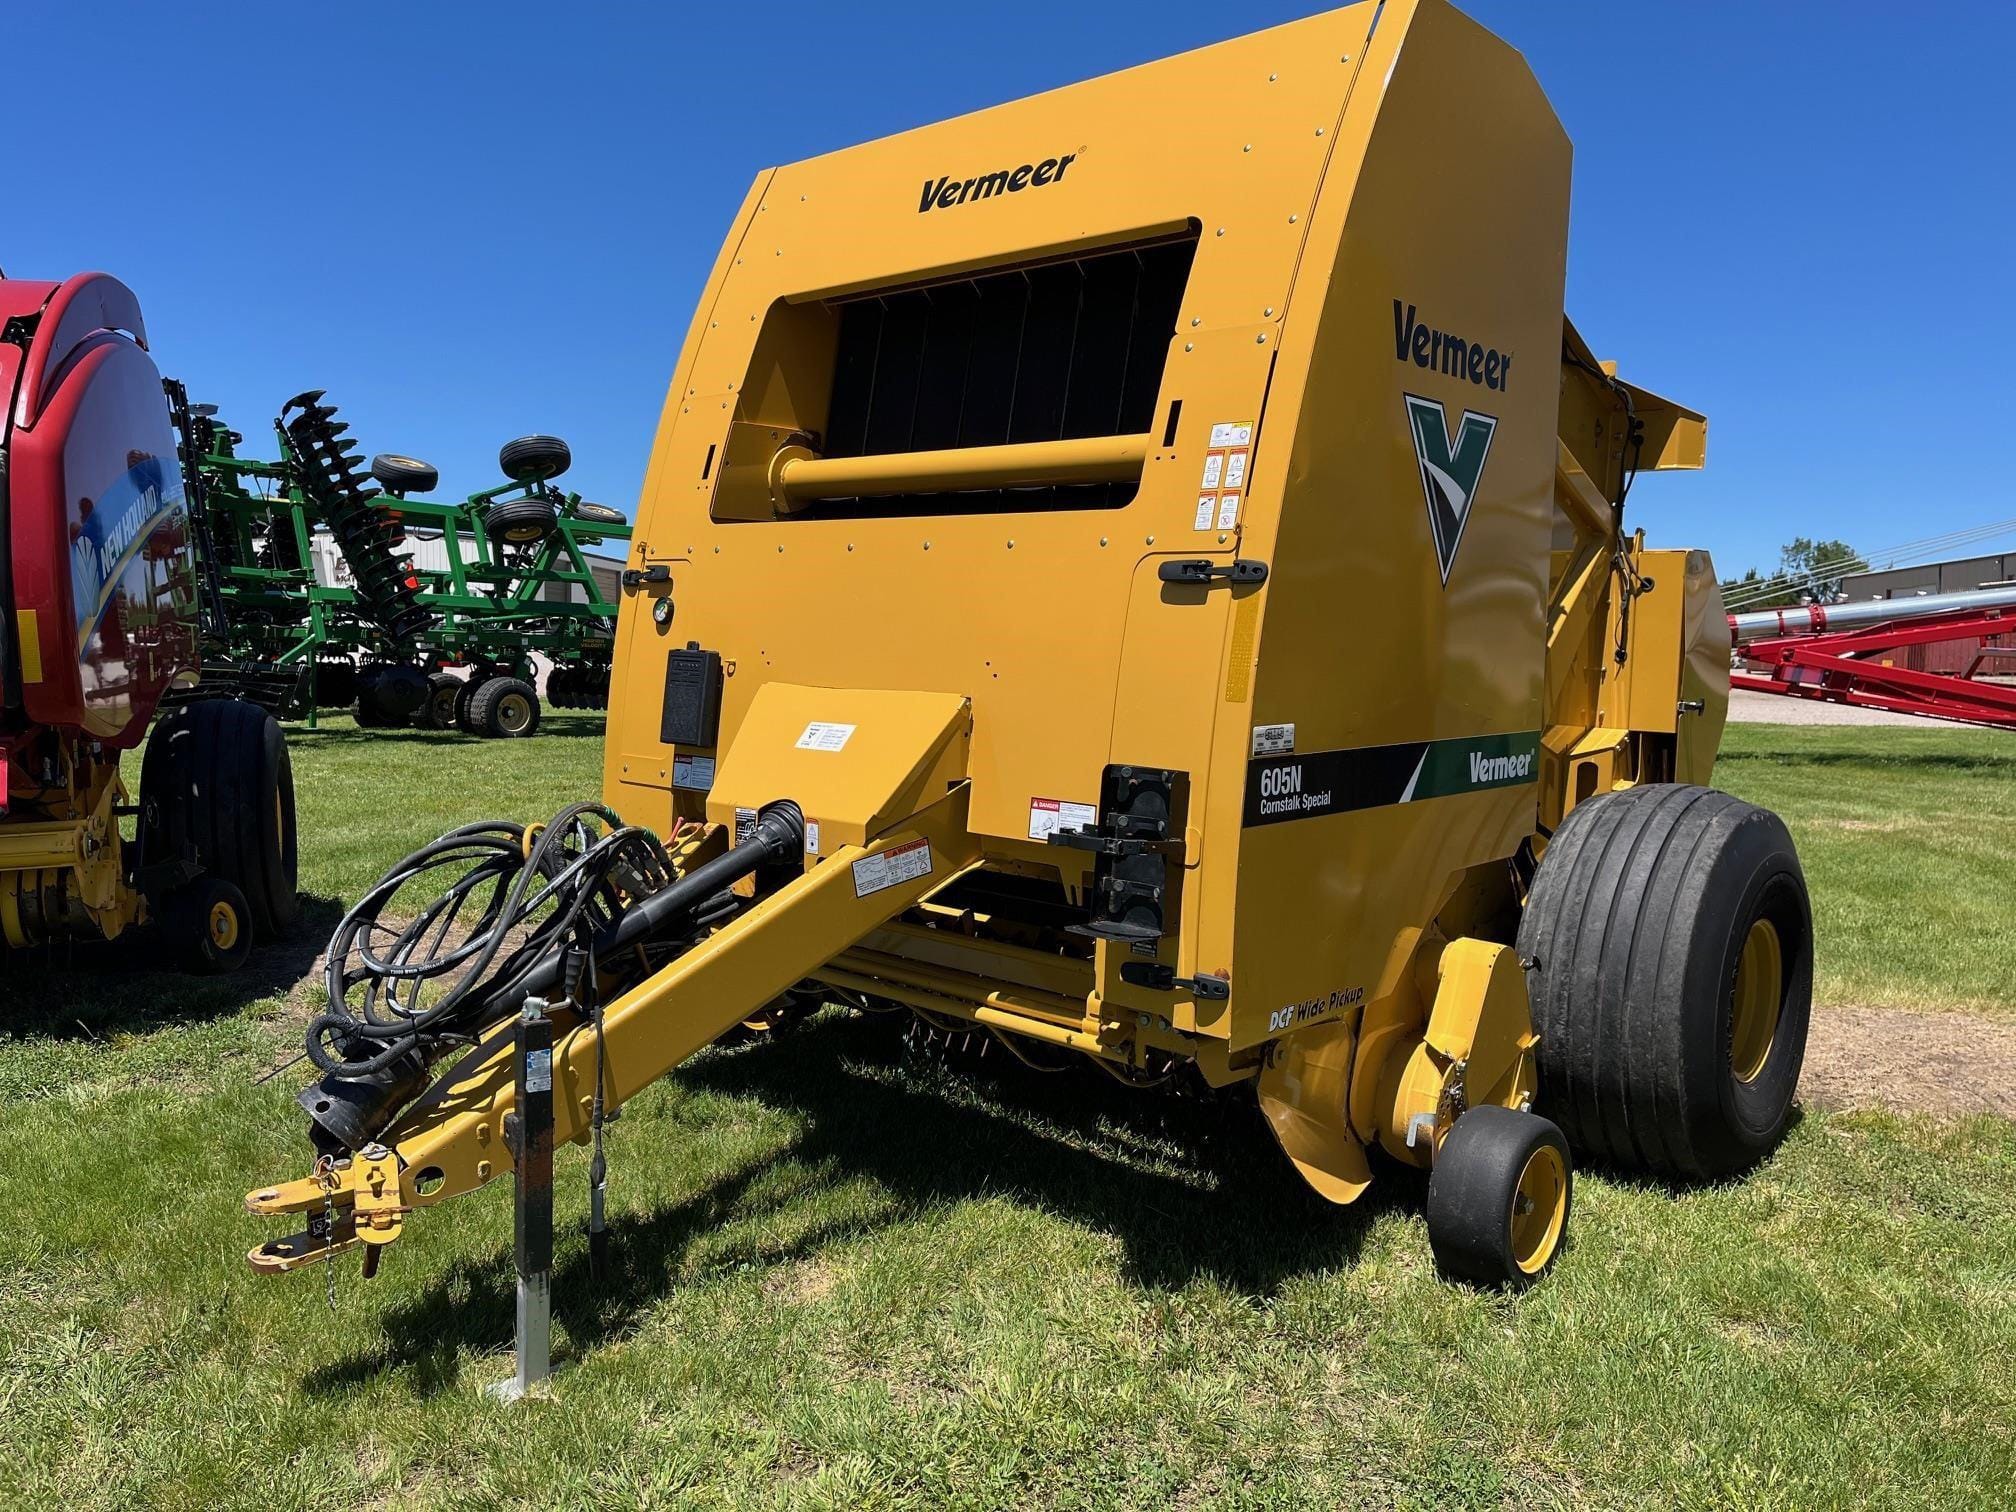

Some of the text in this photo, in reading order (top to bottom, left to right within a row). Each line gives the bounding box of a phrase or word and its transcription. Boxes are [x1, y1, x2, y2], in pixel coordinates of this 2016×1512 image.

[918, 153, 1077, 213] Vermeer
[1393, 298, 1510, 392] Vermeer
[100, 484, 158, 580] NEW HOLLAND
[1260, 765, 1302, 797] 605N
[1470, 751, 1532, 783] Vermeer
[1260, 790, 1331, 815] Cornstalk Special
[1268, 986, 1364, 1033] DCF Wide Pickup
